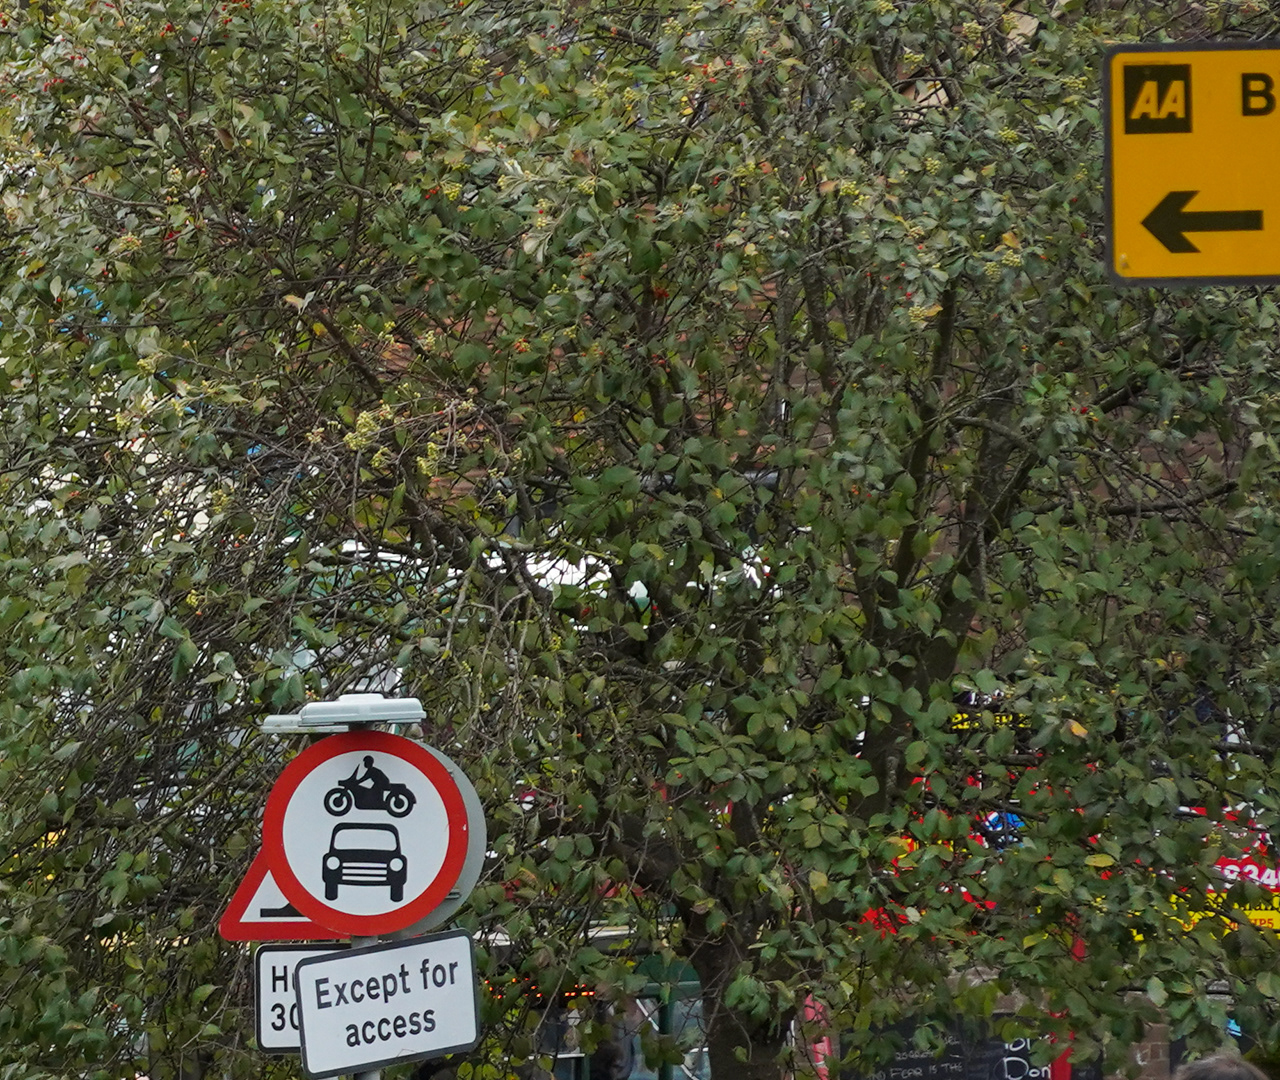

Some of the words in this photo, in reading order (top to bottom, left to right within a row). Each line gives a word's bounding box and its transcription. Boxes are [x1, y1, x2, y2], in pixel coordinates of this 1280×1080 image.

[1129, 79, 1186, 120] AA
[271, 965, 296, 993] H
[314, 963, 412, 1010] Except
[419, 958, 459, 990] for
[344, 1008, 437, 1048] access
[889, 1066, 924, 1079] FEAR
[940, 1061, 964, 1074] THE
